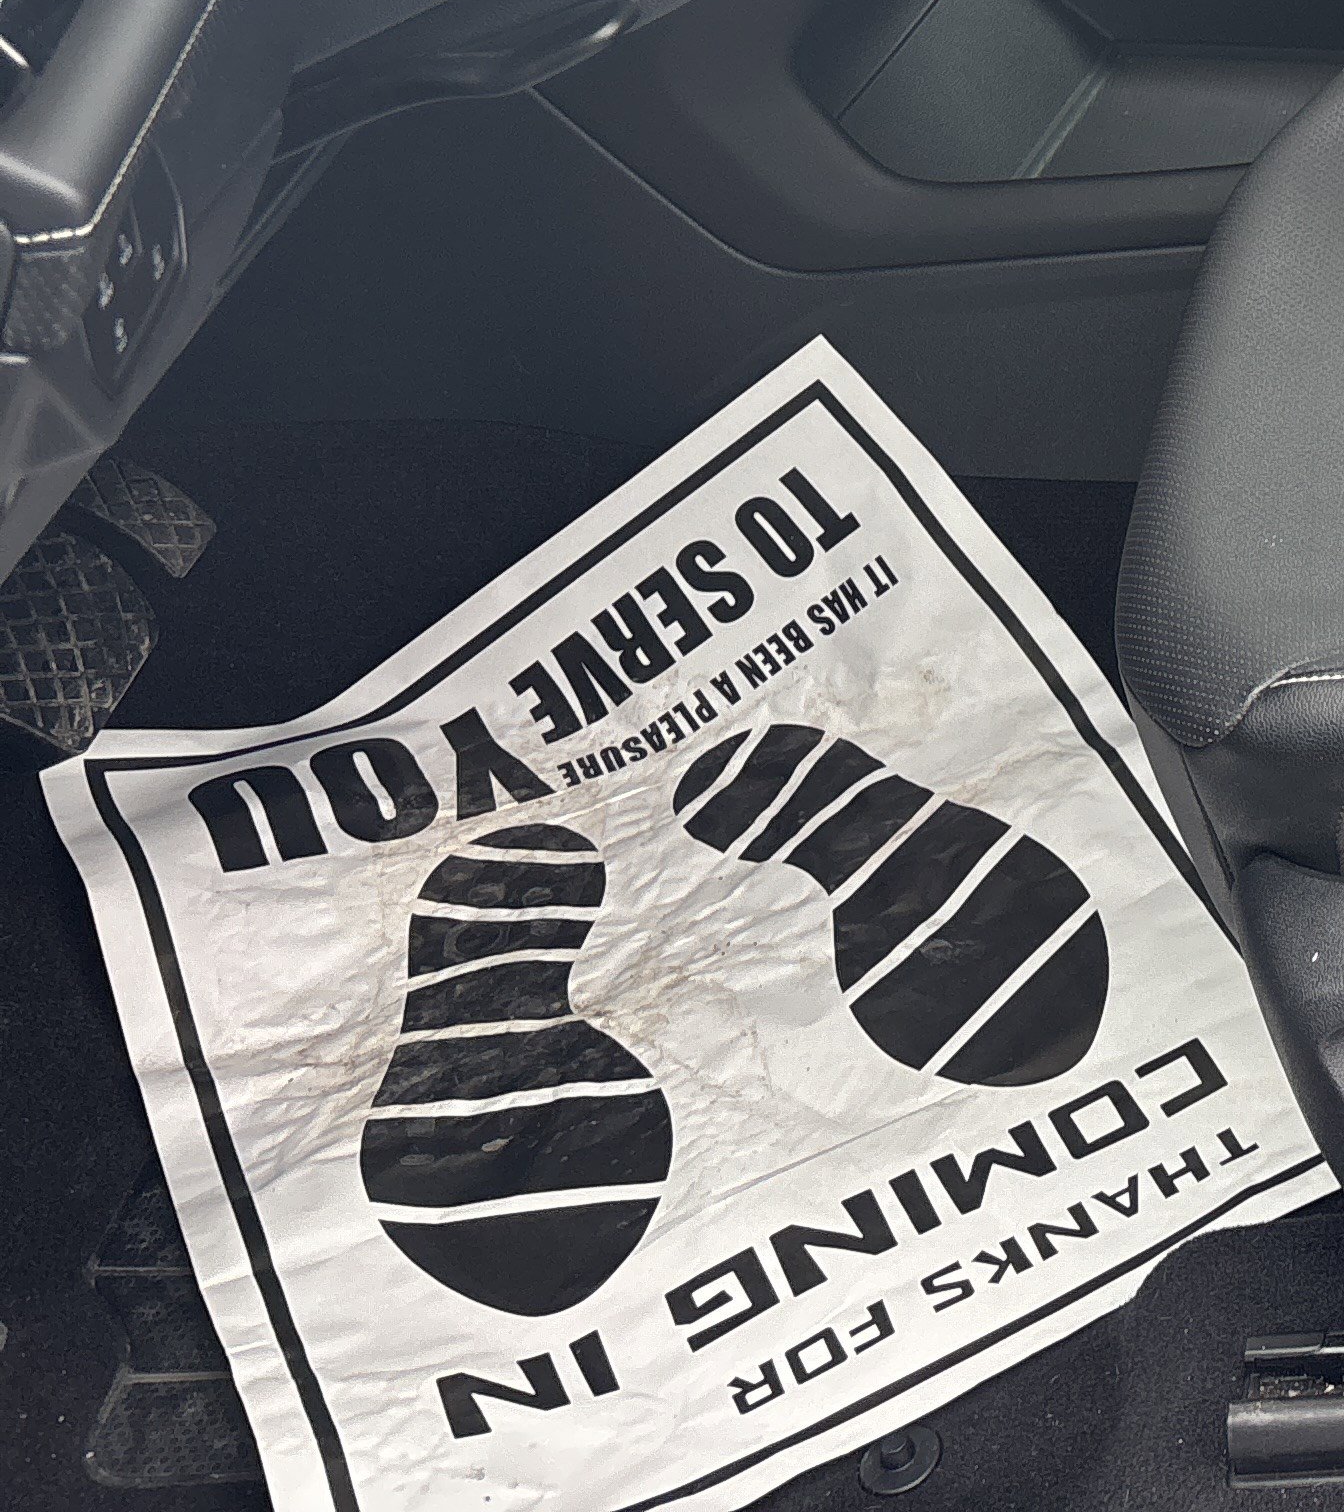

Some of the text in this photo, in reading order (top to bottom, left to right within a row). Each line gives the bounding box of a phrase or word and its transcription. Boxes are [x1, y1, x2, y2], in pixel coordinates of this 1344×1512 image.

[187, 466, 861, 873] TO SERVE YOU
[556, 554, 900, 788] IT HAS BEEN A PLEASURE
[435, 1037, 1229, 1439] COMING IN
[727, 1127, 1260, 1415] THANKS FOR
